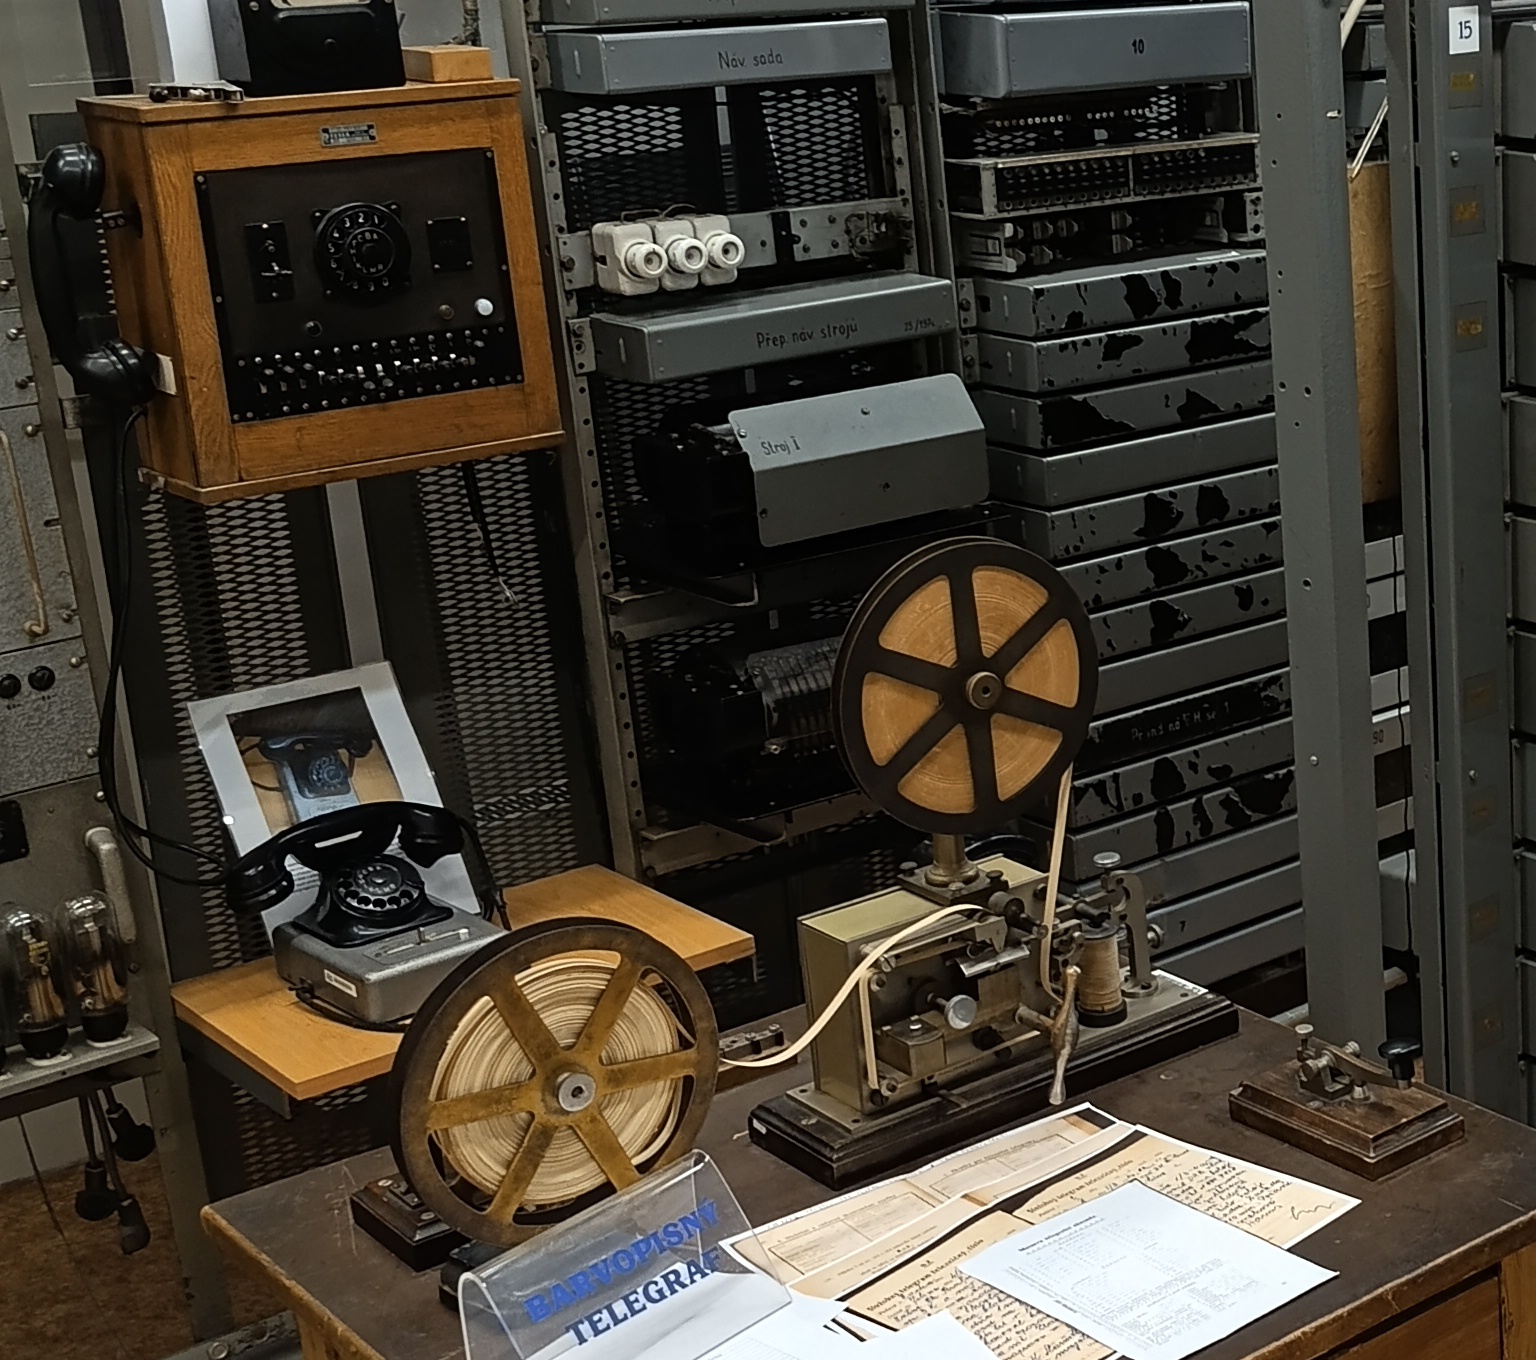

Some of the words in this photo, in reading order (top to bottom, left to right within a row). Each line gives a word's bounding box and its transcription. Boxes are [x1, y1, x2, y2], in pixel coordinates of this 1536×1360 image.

[1457, 19, 1473, 40] 15
[1131, 38, 1145, 56] 10
[753, 51, 783, 68] sada
[820, 318, 858, 341] strojů
[760, 440, 790, 456] Stroj
[523, 1196, 720, 1325] BARVOPISNÝ
[565, 1246, 721, 1346] TELEGRAF
